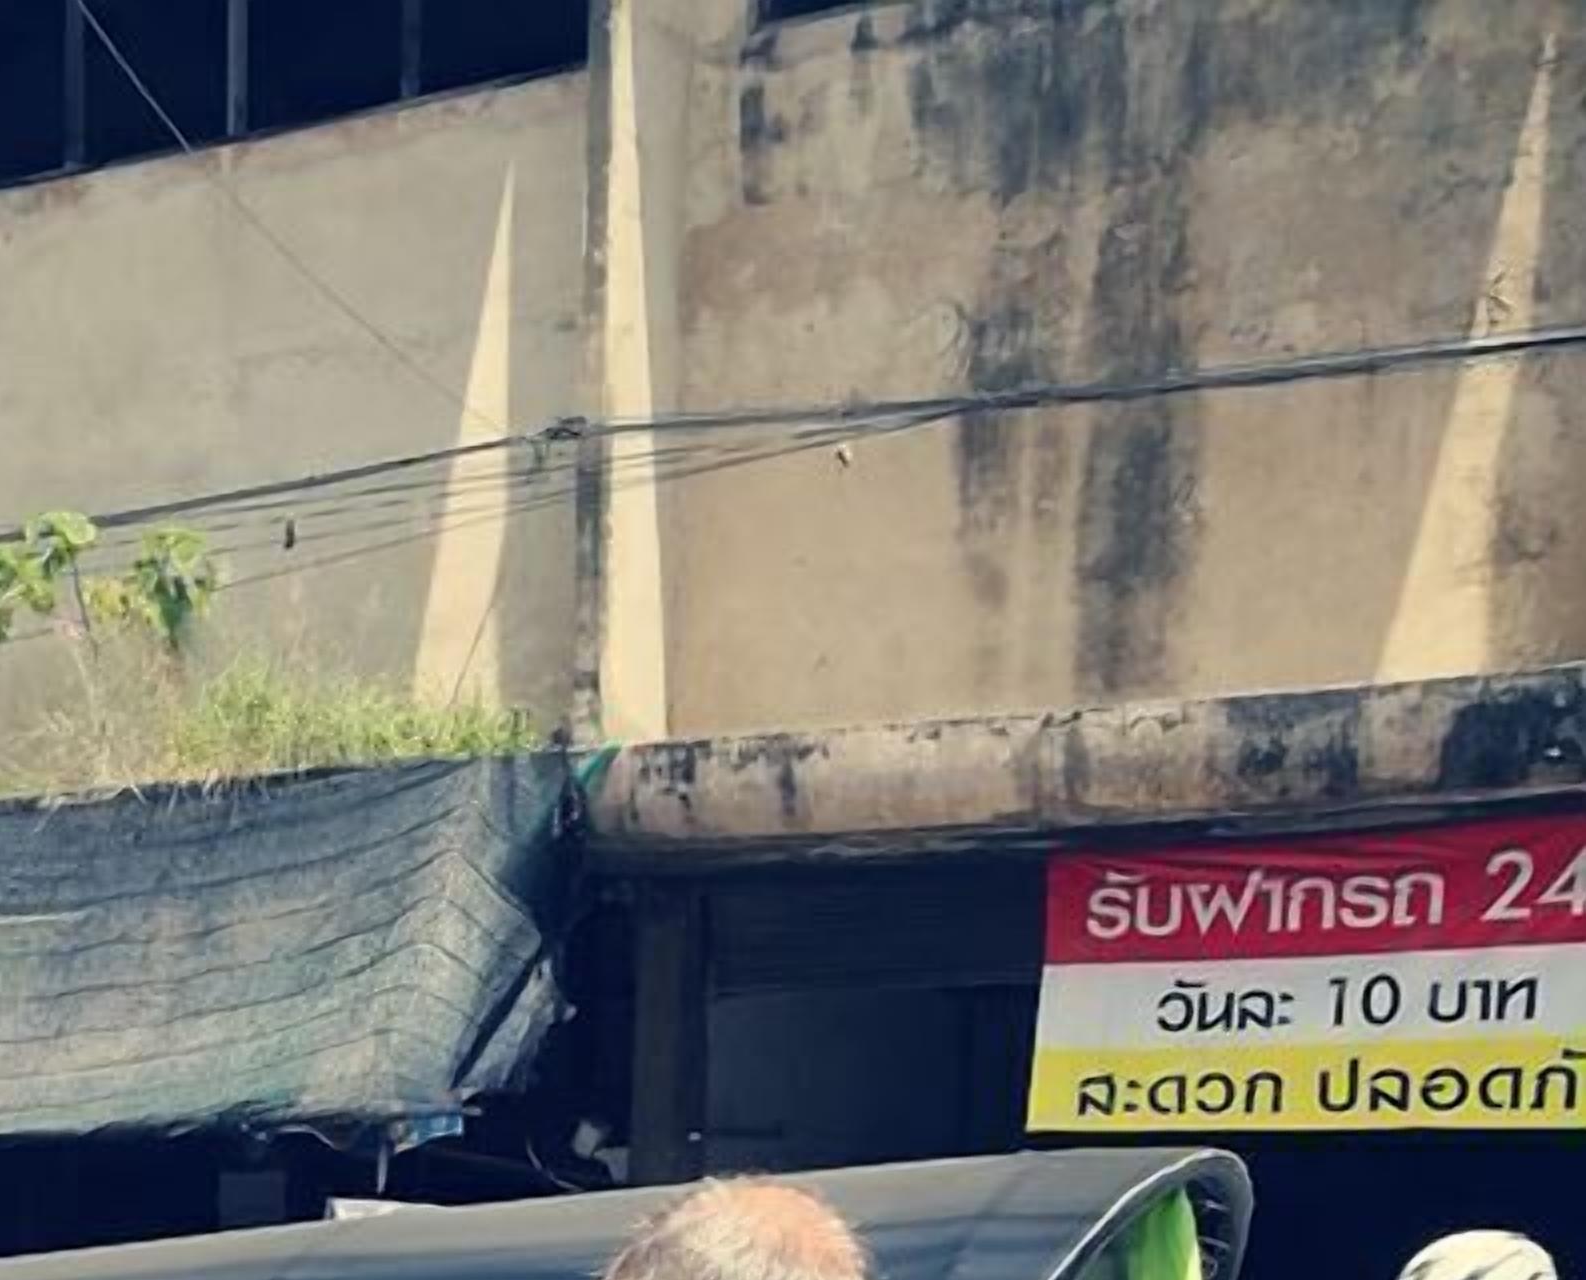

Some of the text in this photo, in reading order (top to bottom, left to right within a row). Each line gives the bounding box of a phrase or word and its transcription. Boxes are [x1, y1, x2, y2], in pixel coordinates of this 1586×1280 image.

[1480, 846, 1586, 922] 24
[1156, 974, 1538, 1033] วันละ 10 บาท
[1077, 1073, 1283, 1117] สะดวก
